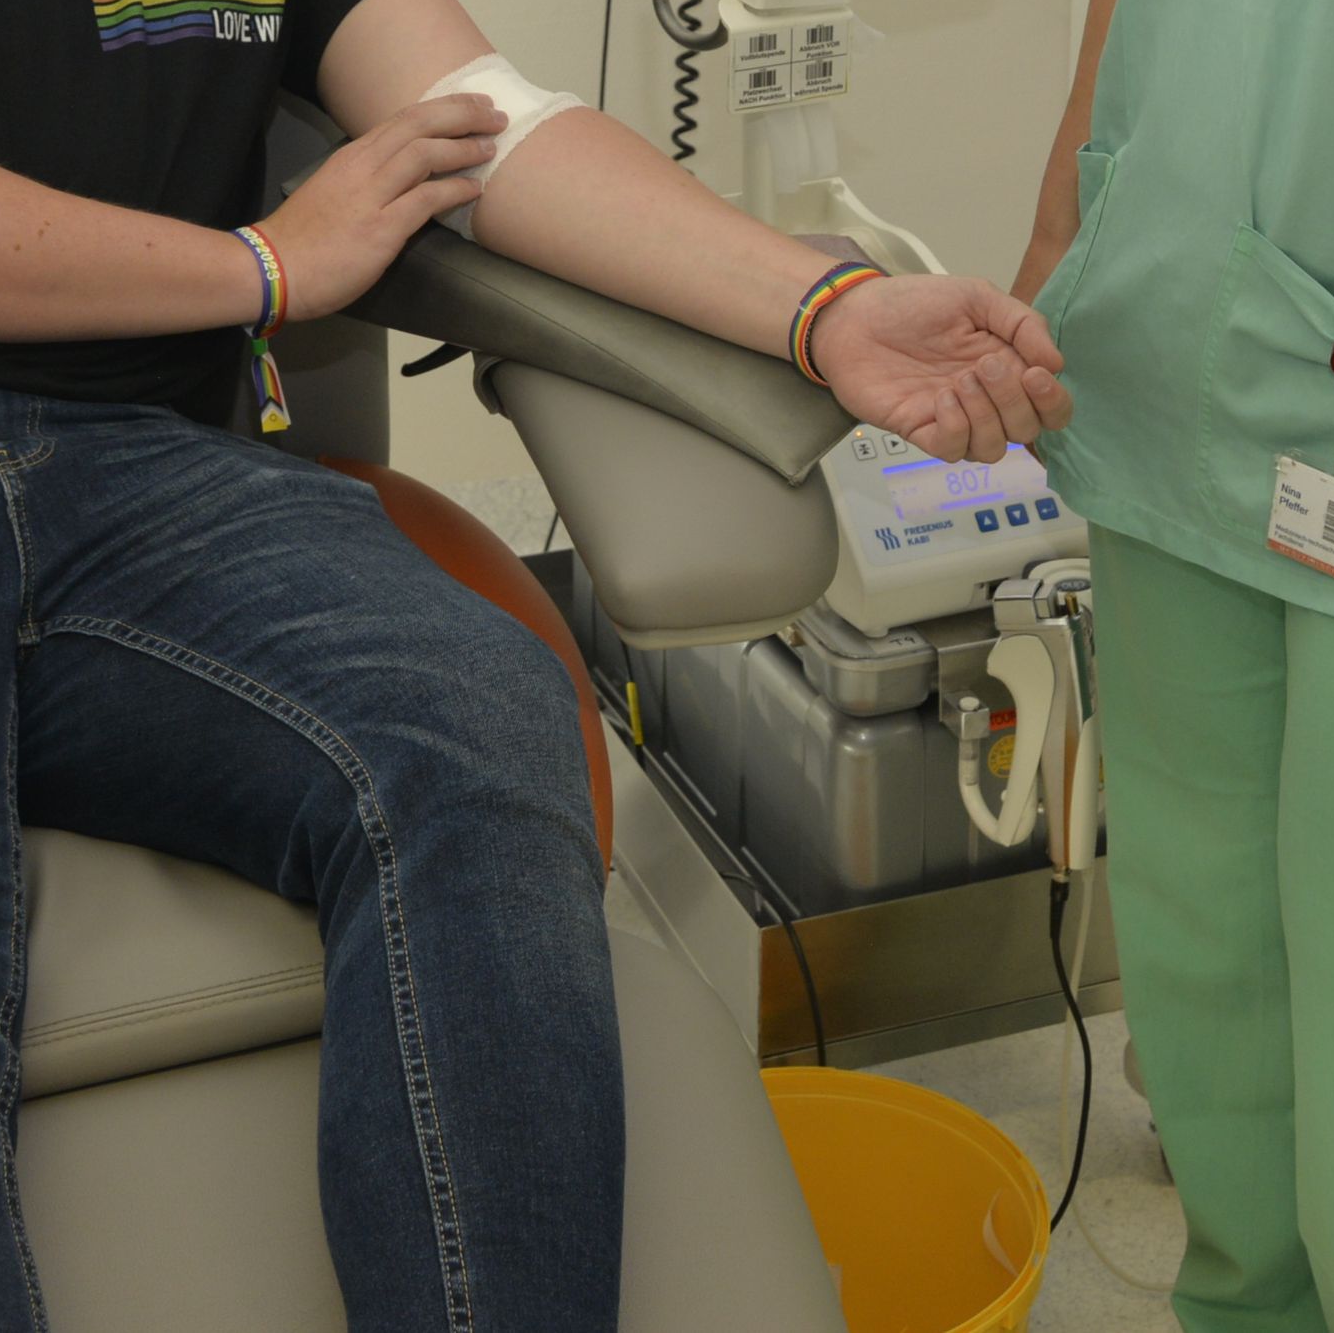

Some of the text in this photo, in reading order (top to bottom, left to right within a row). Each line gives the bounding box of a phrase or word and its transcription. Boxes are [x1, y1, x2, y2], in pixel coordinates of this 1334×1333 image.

[212, 9, 252, 43] LOVE
[946, 465, 990, 496] 807
[1280, 483, 1302, 500] Nina
[1279, 496, 1309, 516] Pfeffer
[904, 520, 954, 536] FRESENIUS
[907, 535, 931, 546] KABI
